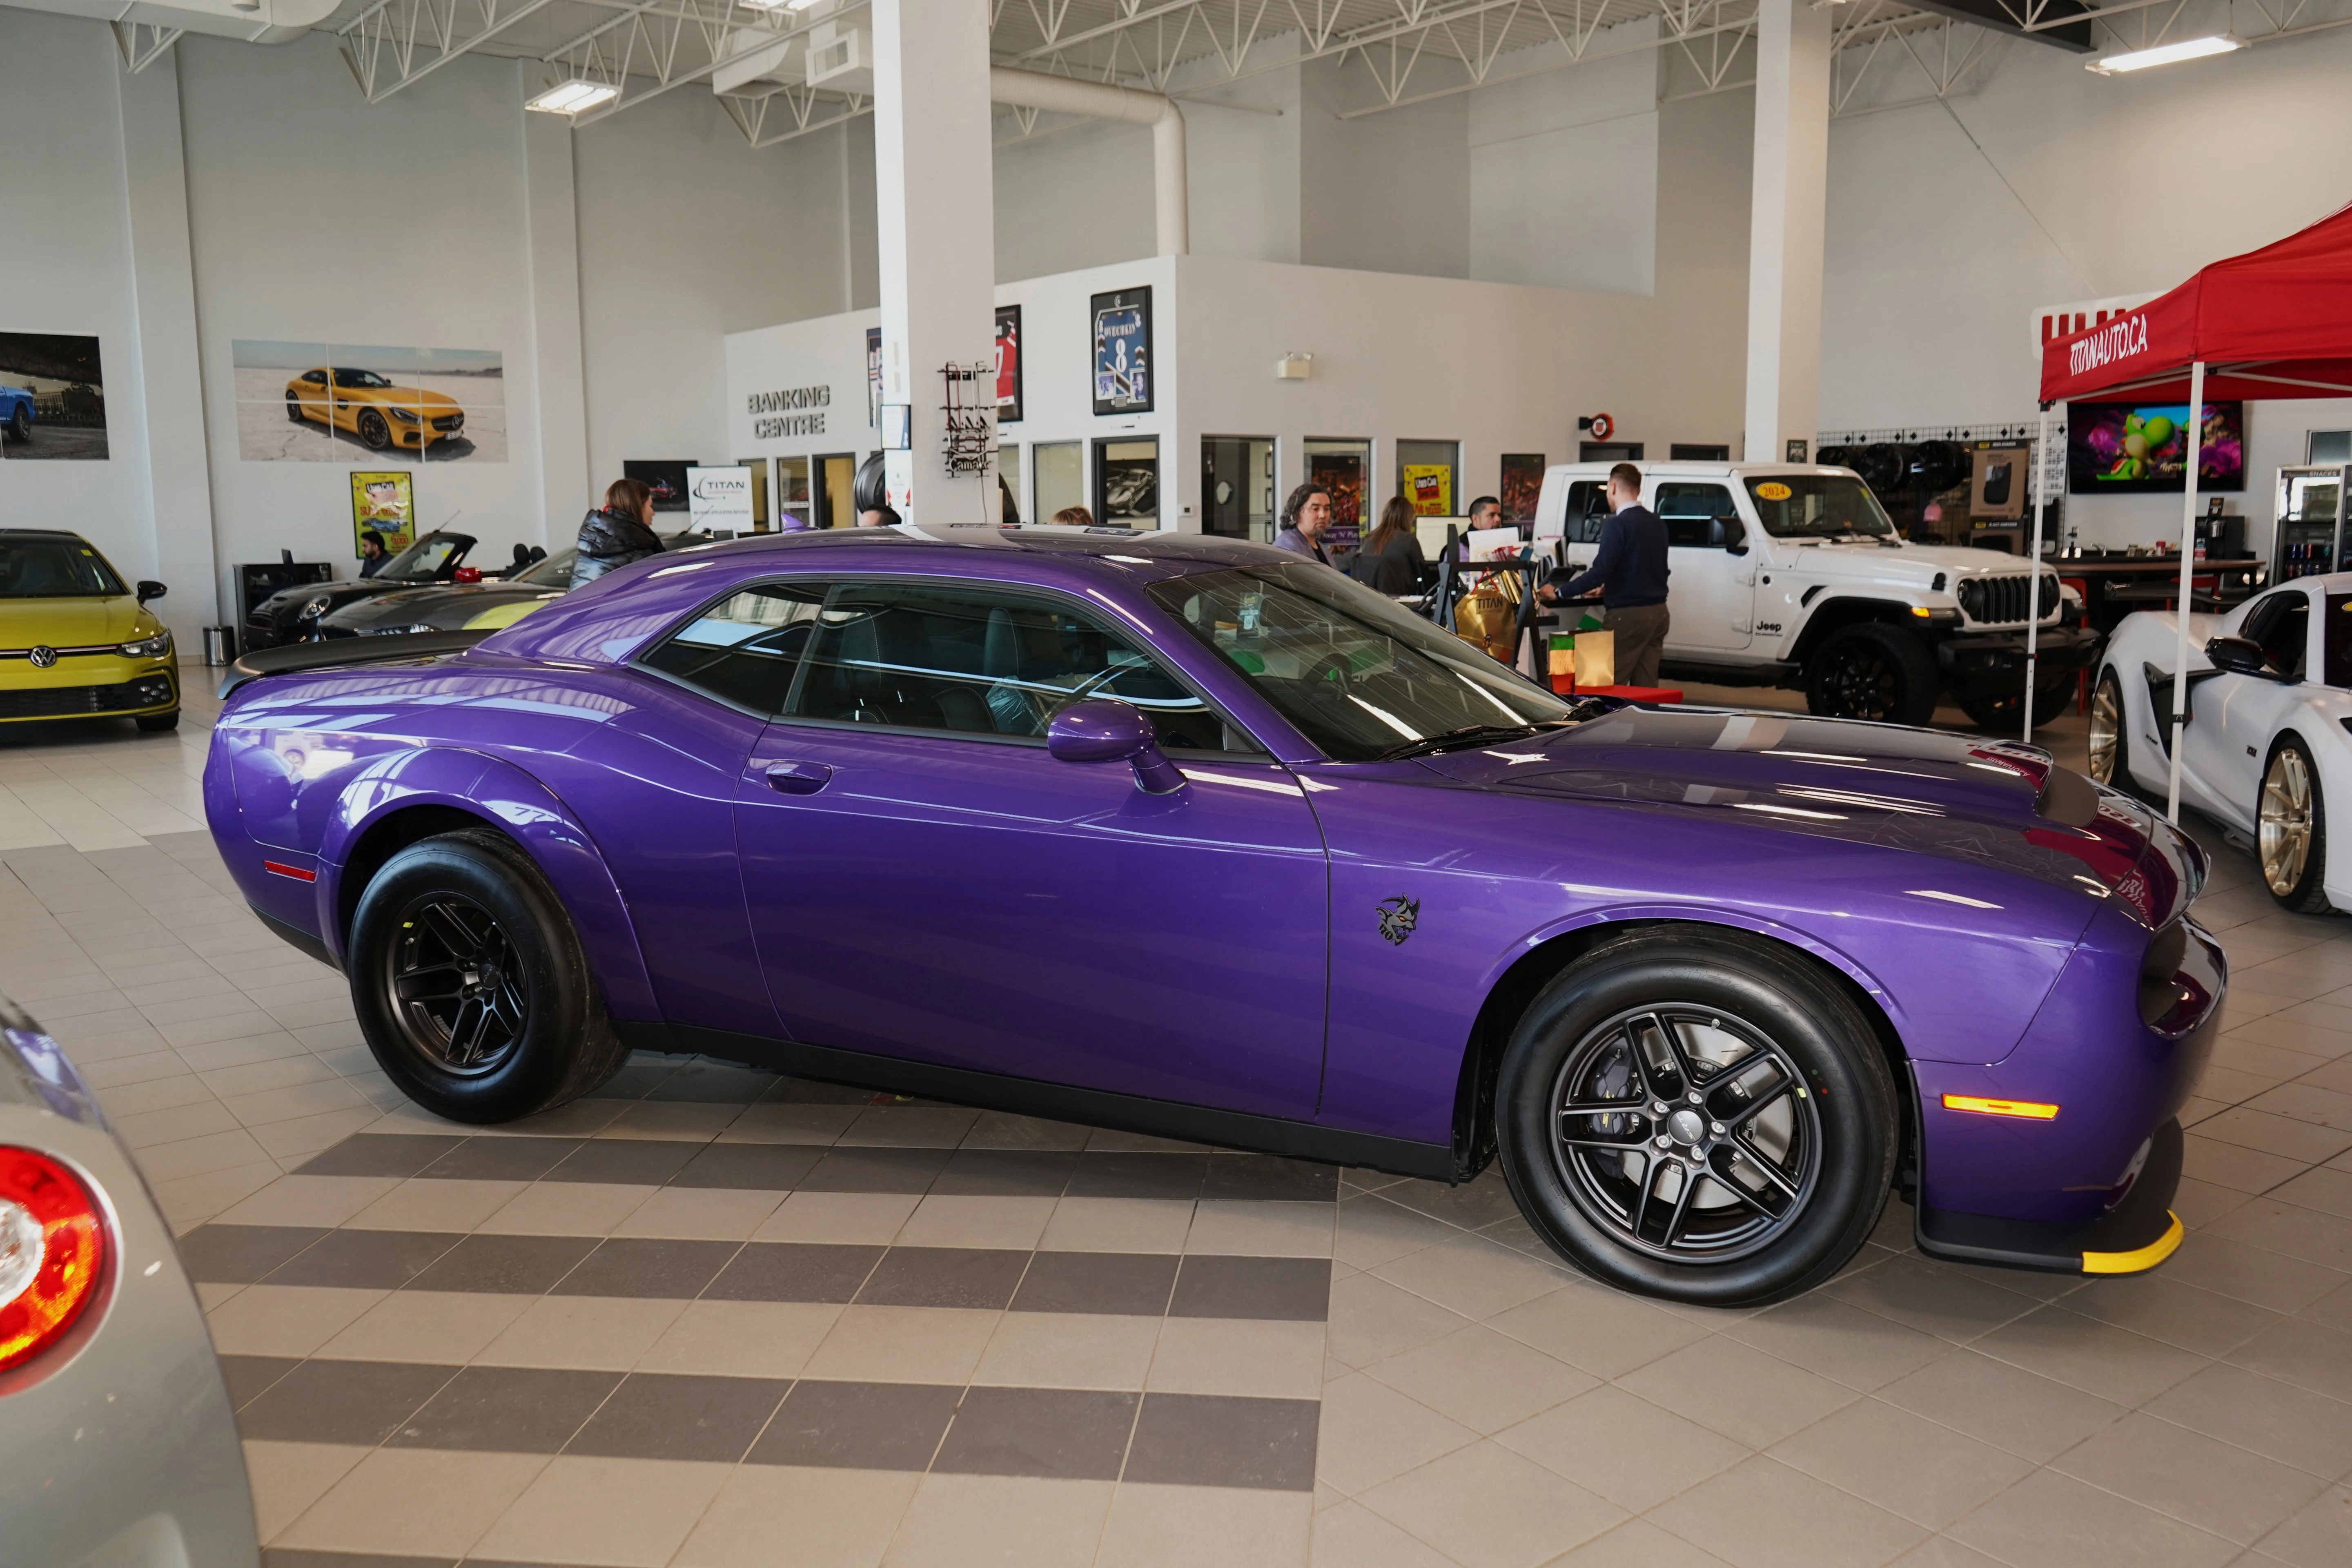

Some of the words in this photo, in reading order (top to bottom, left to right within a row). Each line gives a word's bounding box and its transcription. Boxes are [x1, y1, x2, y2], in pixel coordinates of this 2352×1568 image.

[1115, 338, 1127, 373] 8
[2070, 313, 2148, 377] TITANAUTO.CA
[748, 385, 830, 414] BANKING
[754, 412, 825, 439] CENTRE
[1763, 485, 1785, 497] 2024
[1477, 597, 1503, 609] TITAN
[1757, 621, 1782, 633] Jeep
[1379, 923, 1393, 940] 170
[1676, 1114, 1696, 1140] SRT
